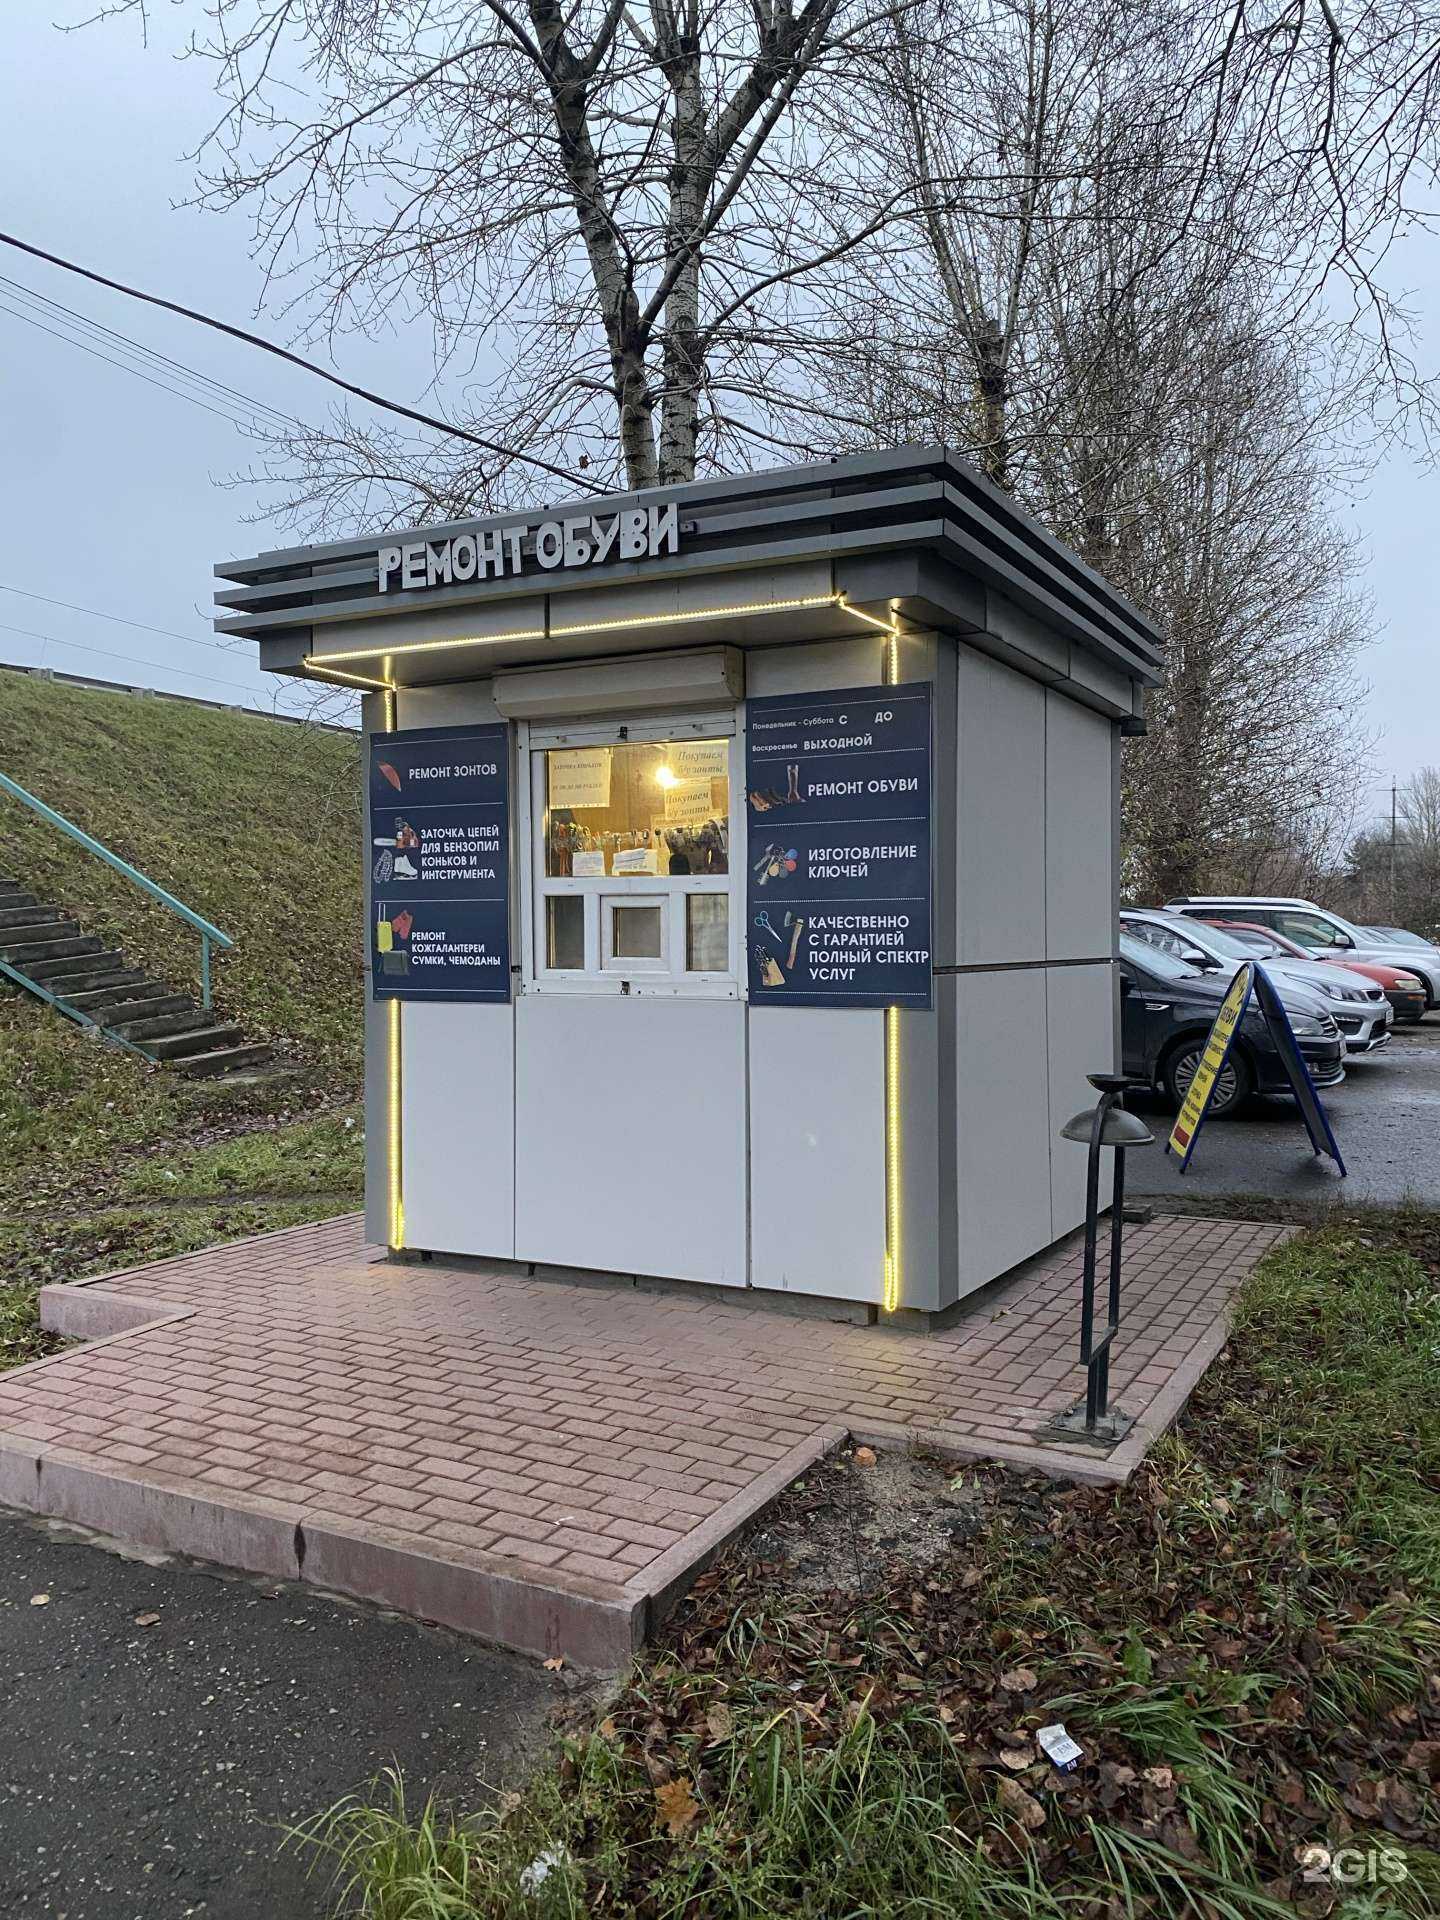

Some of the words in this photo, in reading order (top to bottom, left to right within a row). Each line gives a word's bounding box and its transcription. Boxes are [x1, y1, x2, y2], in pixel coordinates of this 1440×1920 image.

[378, 525, 528, 592] РЕМОНТ
[536, 502, 679, 569] ОБУВИ
[803, 716, 834, 727] Суббота
[839, 715, 848, 725] С
[874, 711, 893, 724] ДО
[752, 742, 798, 753] Воскресенье
[803, 733, 873, 751] ВЫХОДНОЙ
[408, 765, 452, 781] РЕМОНТ
[454, 763, 497, 777] ЗОНТОВ
[808, 781, 864, 797] РЕМОНТ
[868, 777, 919, 792] ОБУВИ
[421, 828, 465, 839] ЗАТОЧКА
[467, 825, 499, 838] ЦЕПЕЙ
[420, 842, 441, 855] ДЛЯ
[443, 841, 499, 853] БЕНЗОПИЛ
[808, 845, 917, 861] ИЗГОТОВЛЕНИЕ
[421, 856, 467, 867] КОНЬКОВ
[469, 856, 477, 865] И
[421, 869, 496, 880] ИНТСТРУМЕНТА
[808, 862, 868, 879] КЛЮЧЕЙ
[808, 915, 910, 929] КАЧЕСТВЕННО
[411, 931, 446, 941] РЕМОНТ
[808, 934, 820, 946] С
[823, 930, 904, 946] ГАРАНТИЕЙ
[411, 943, 485, 953] КОЖГАЛАНТЕРЕИ
[411, 955, 447, 967] СУМКИ,
[449, 954, 501, 967] ЧЕМОДАНЫ
[809, 948, 871, 963] ПОЛНЫЙ
[875, 950, 929, 964] СПЕКТР
[809, 968, 856, 980] УСЛУГ
